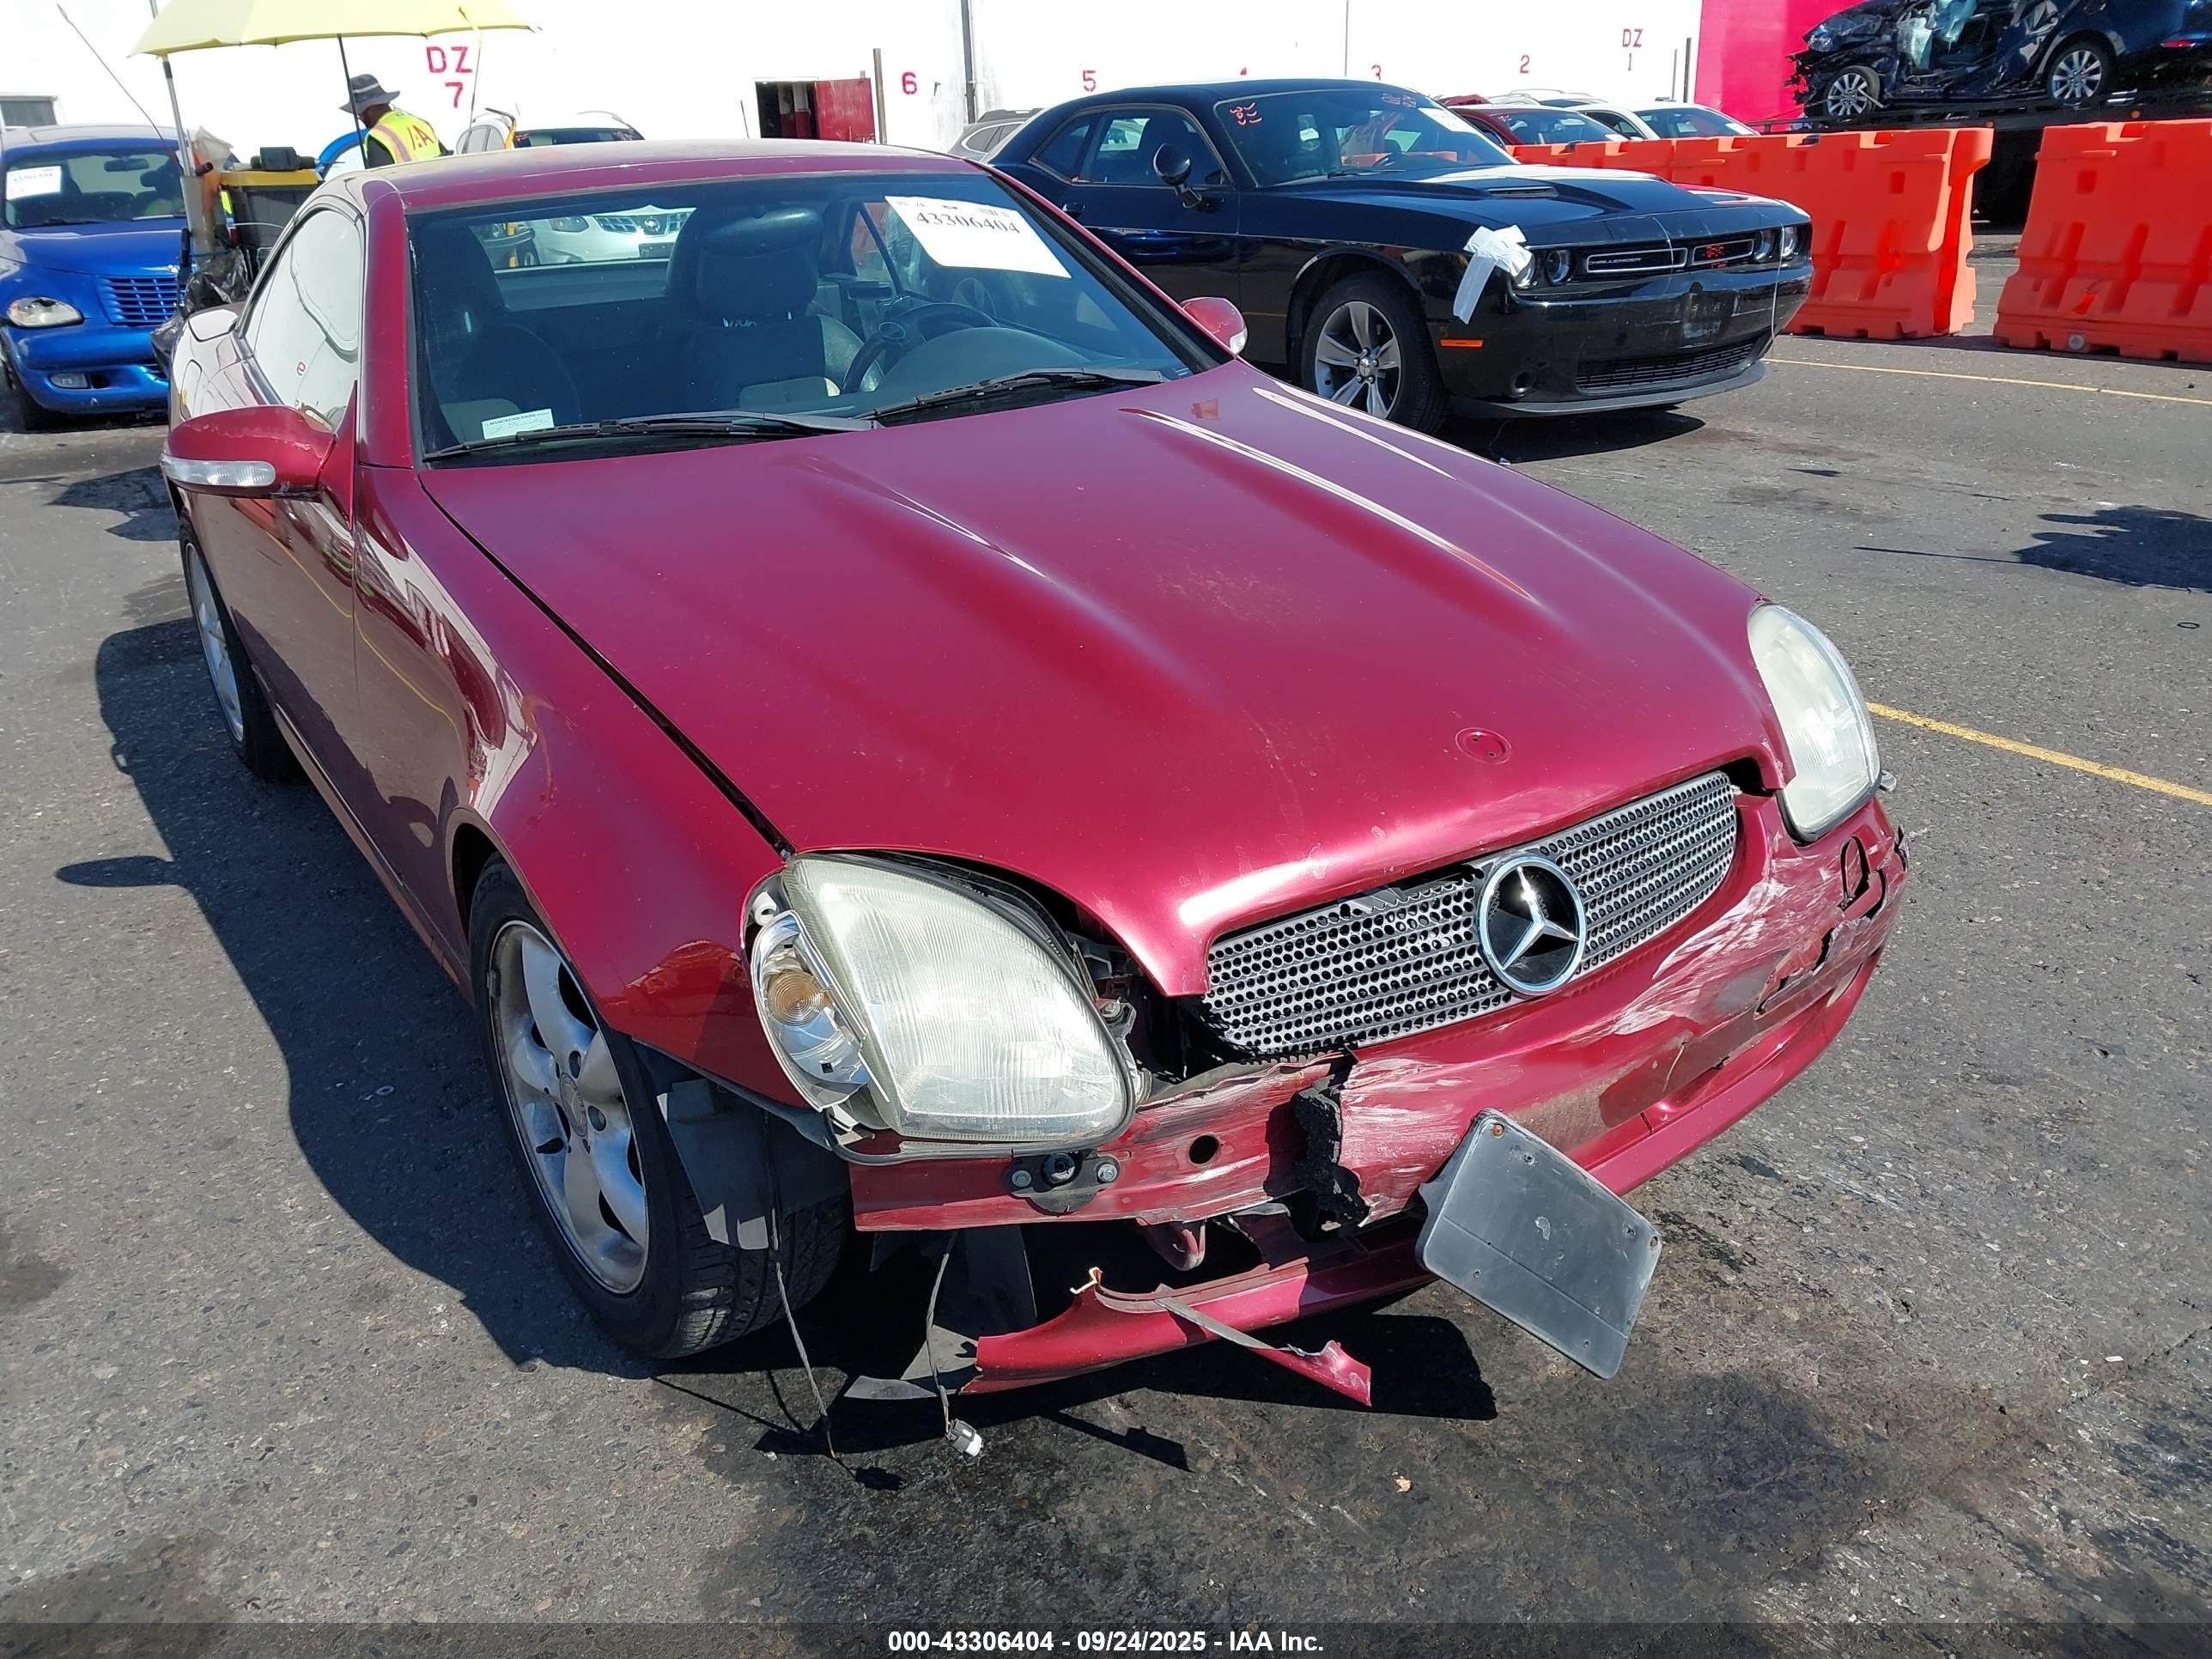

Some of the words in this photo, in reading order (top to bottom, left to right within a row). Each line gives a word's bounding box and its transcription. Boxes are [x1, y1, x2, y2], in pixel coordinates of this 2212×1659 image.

[1622, 28, 1643, 47] DZ
[426, 46, 472, 73] DZ
[1520, 55, 1529, 73] 2
[902, 72, 916, 94] 6
[1083, 70, 1096, 92] 5
[445, 82, 463, 108] 7
[916, 212, 1020, 234] 43306404
